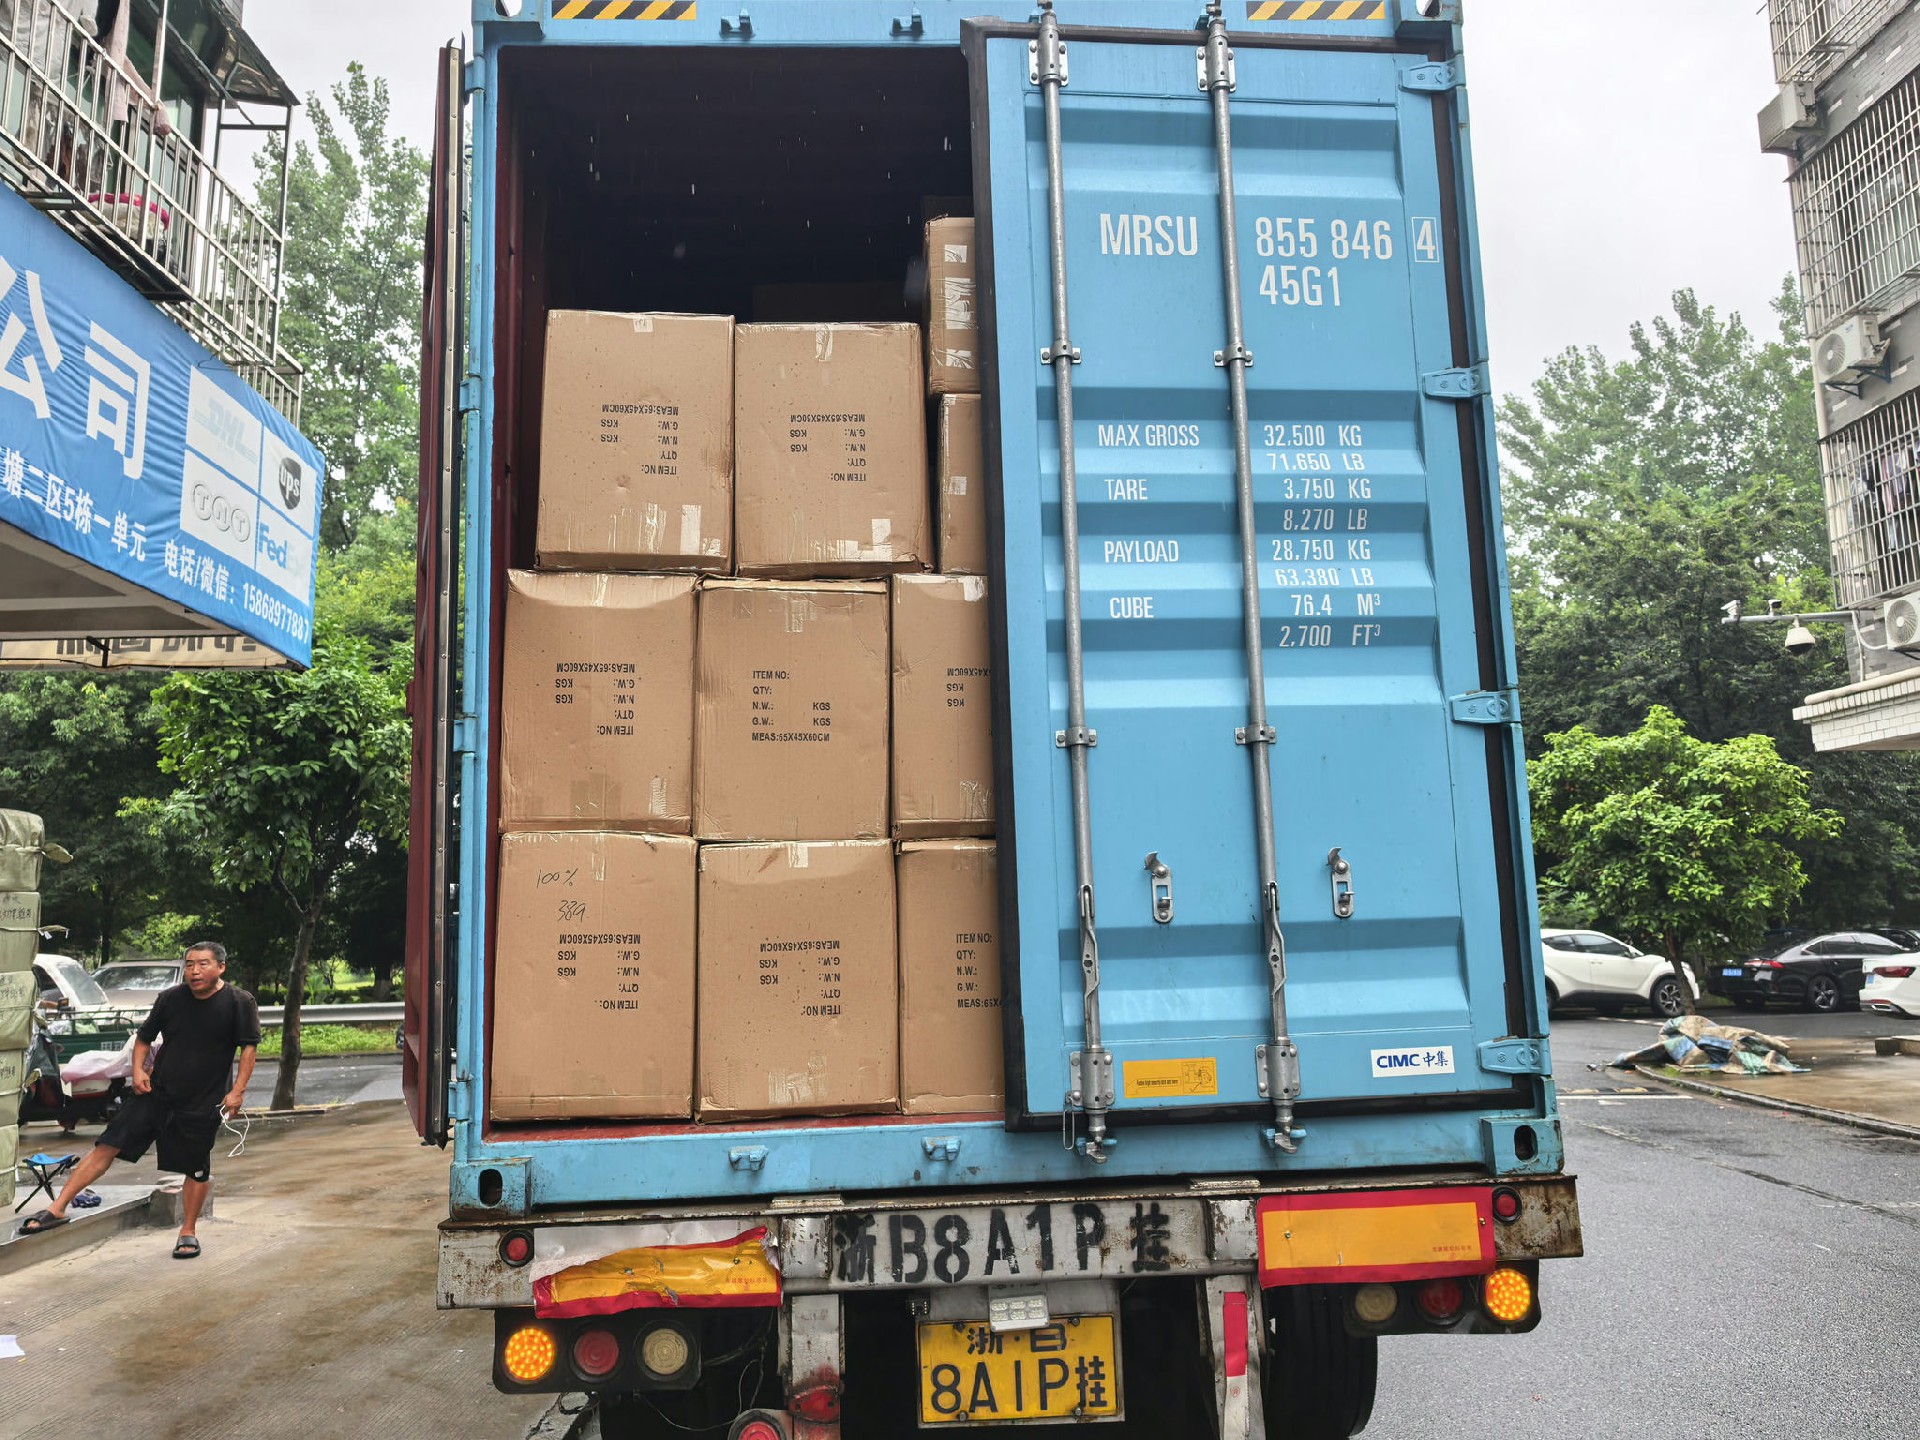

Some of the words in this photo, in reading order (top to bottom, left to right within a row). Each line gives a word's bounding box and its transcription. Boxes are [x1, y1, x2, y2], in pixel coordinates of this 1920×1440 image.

[1100, 213, 1198, 256] MRSU
[1255, 217, 1318, 258] 855
[1330, 219, 1393, 260] 846
[1417, 220, 1436, 260] 4
[1259, 265, 1341, 306] 45G1
[0, 256, 150, 480] 公司
[600, 419, 619, 428] KGS
[600, 434, 619, 443] KGS
[789, 429, 807, 438] KGS
[1098, 424, 1141, 447] MAX
[1144, 424, 1200, 447] GROSS
[1263, 425, 1326, 447] 32,500
[1338, 425, 1363, 447] KG
[790, 444, 808, 453] KGS
[847, 457, 867, 467] QTY:
[1342, 453, 1366, 471] LB
[658, 465, 677, 475] ITEM
[830, 472, 846, 482] NO:
[846, 472, 867, 482] ITEM
[1104, 479, 1149, 501] TARE
[1348, 478, 1372, 500] KG
[1283, 509, 1335, 531] 8,270
[1347, 509, 1368, 531] LB
[1104, 540, 1180, 563] PAYLOAD
[1348, 539, 1372, 561] KG
[1351, 568, 1375, 586] LB
[1109, 596, 1155, 619] CUBE
[1290, 594, 1333, 616] 76.4
[243, 582, 309, 645] 15868977887
[752, 670, 773, 680] ITEM
[774, 670, 790, 680] NO:
[555, 678, 573, 688] KGS
[946, 683, 964, 692] KGS
[752, 685, 772, 695] QTY:
[555, 694, 573, 704] KGS
[947, 698, 965, 707] KGS
[752, 701, 774, 711] N.W.:
[812, 702, 831, 711] KGS
[614, 710, 635, 720] QTY:
[752, 716, 774, 726] G.W.:
[812, 717, 831, 726] KGS
[596, 725, 613, 736] NO:
[613, 725, 634, 736] ITEM
[537, 868, 579, 889] 100%
[559, 934, 641, 945] MEAS:65X45X60CM
[956, 933, 976, 944] ITEM
[977, 933, 993, 944] NO:
[557, 950, 576, 960] KGS
[617, 950, 640, 960] G.W.:
[956, 950, 976, 961] QTY:
[759, 959, 778, 969] KGS
[817, 957, 841, 967] G.W.:
[557, 967, 576, 976] KGS
[617, 966, 640, 976] N.W.:
[956, 966, 978, 976] N.W.:
[760, 974, 779, 985] KGS
[818, 972, 841, 982] N.W.:
[618, 983, 639, 993] QTY:
[957, 982, 978, 992] G.W.:
[821, 989, 841, 999] QTY:
[600, 1000, 617, 1010] NO:
[618, 1000, 639, 1010] ITEM
[819, 1004, 841, 1016] ITEM
[801, 1005, 818, 1016] NO:
[1376, 1053, 1421, 1069] CIMC
[1422, 1050, 1449, 1068] 中集
